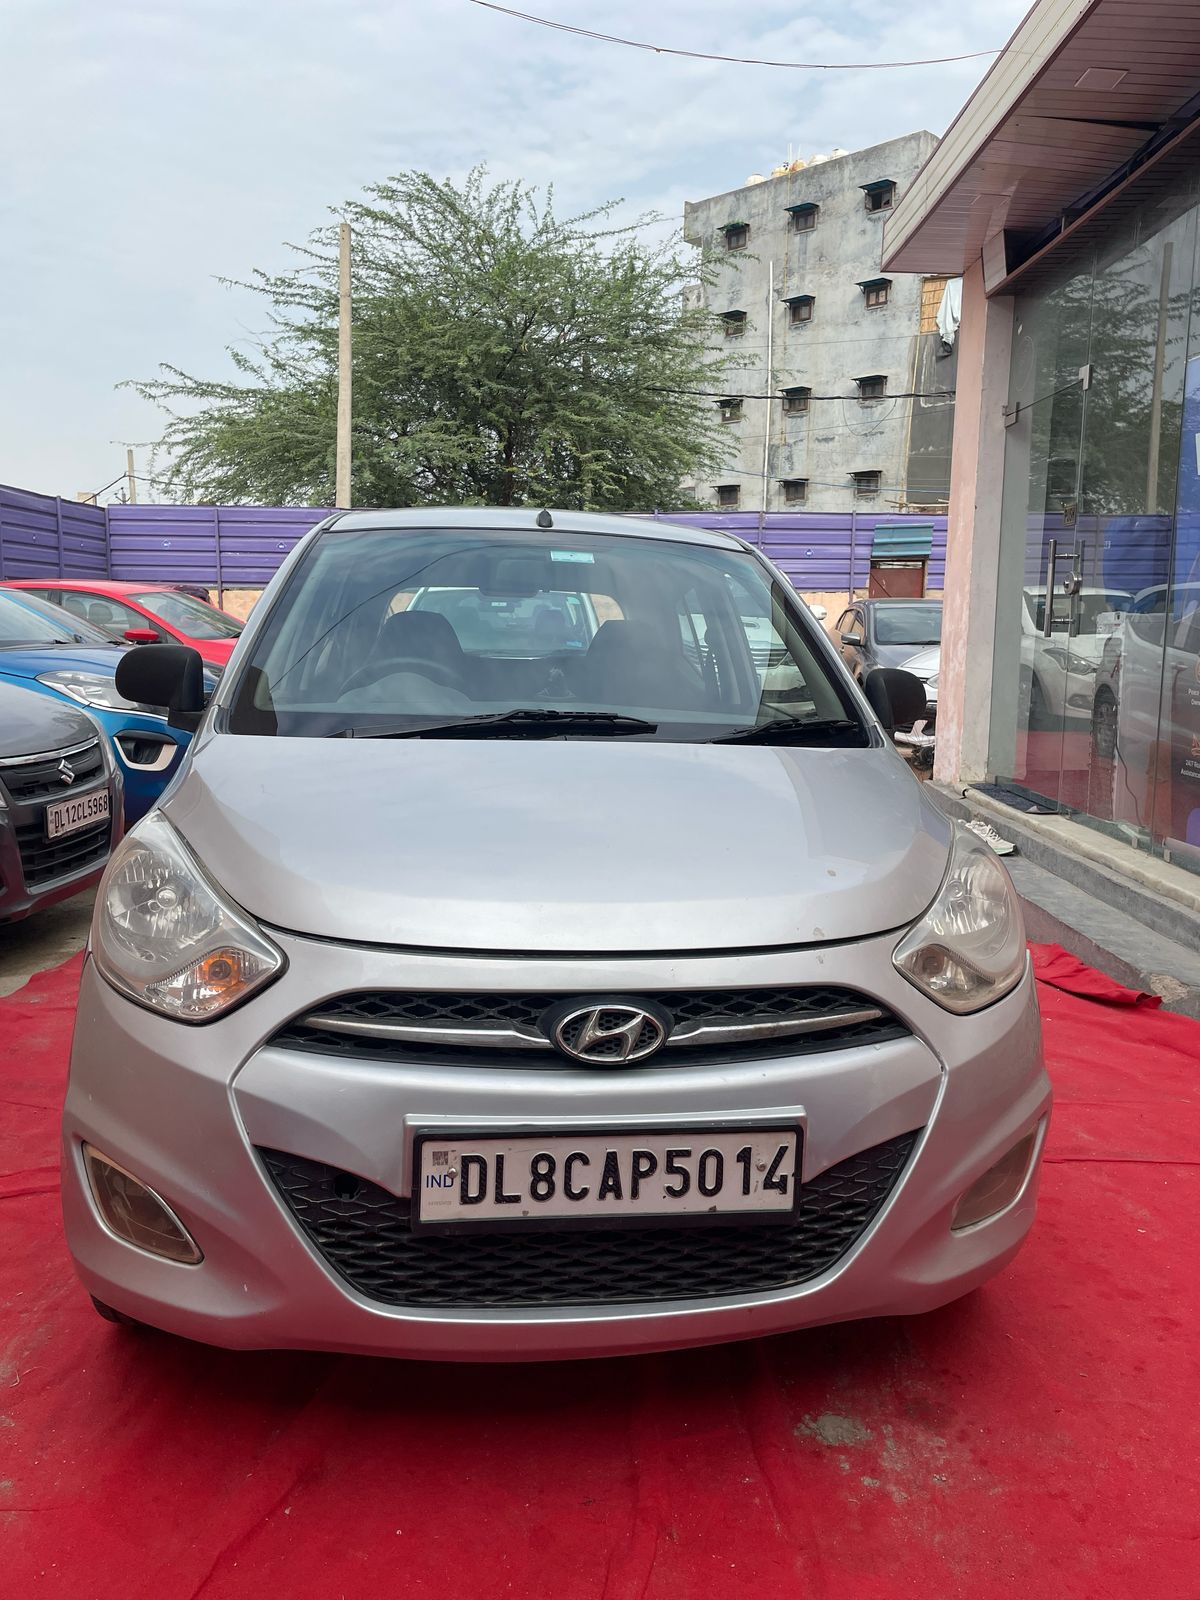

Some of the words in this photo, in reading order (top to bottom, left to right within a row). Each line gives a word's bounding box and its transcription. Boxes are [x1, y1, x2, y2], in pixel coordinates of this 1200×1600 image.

[54, 794, 108, 829] DL12CL5968
[426, 1174, 454, 1188] IND
[459, 1145, 789, 1206] DL8CAP5014
